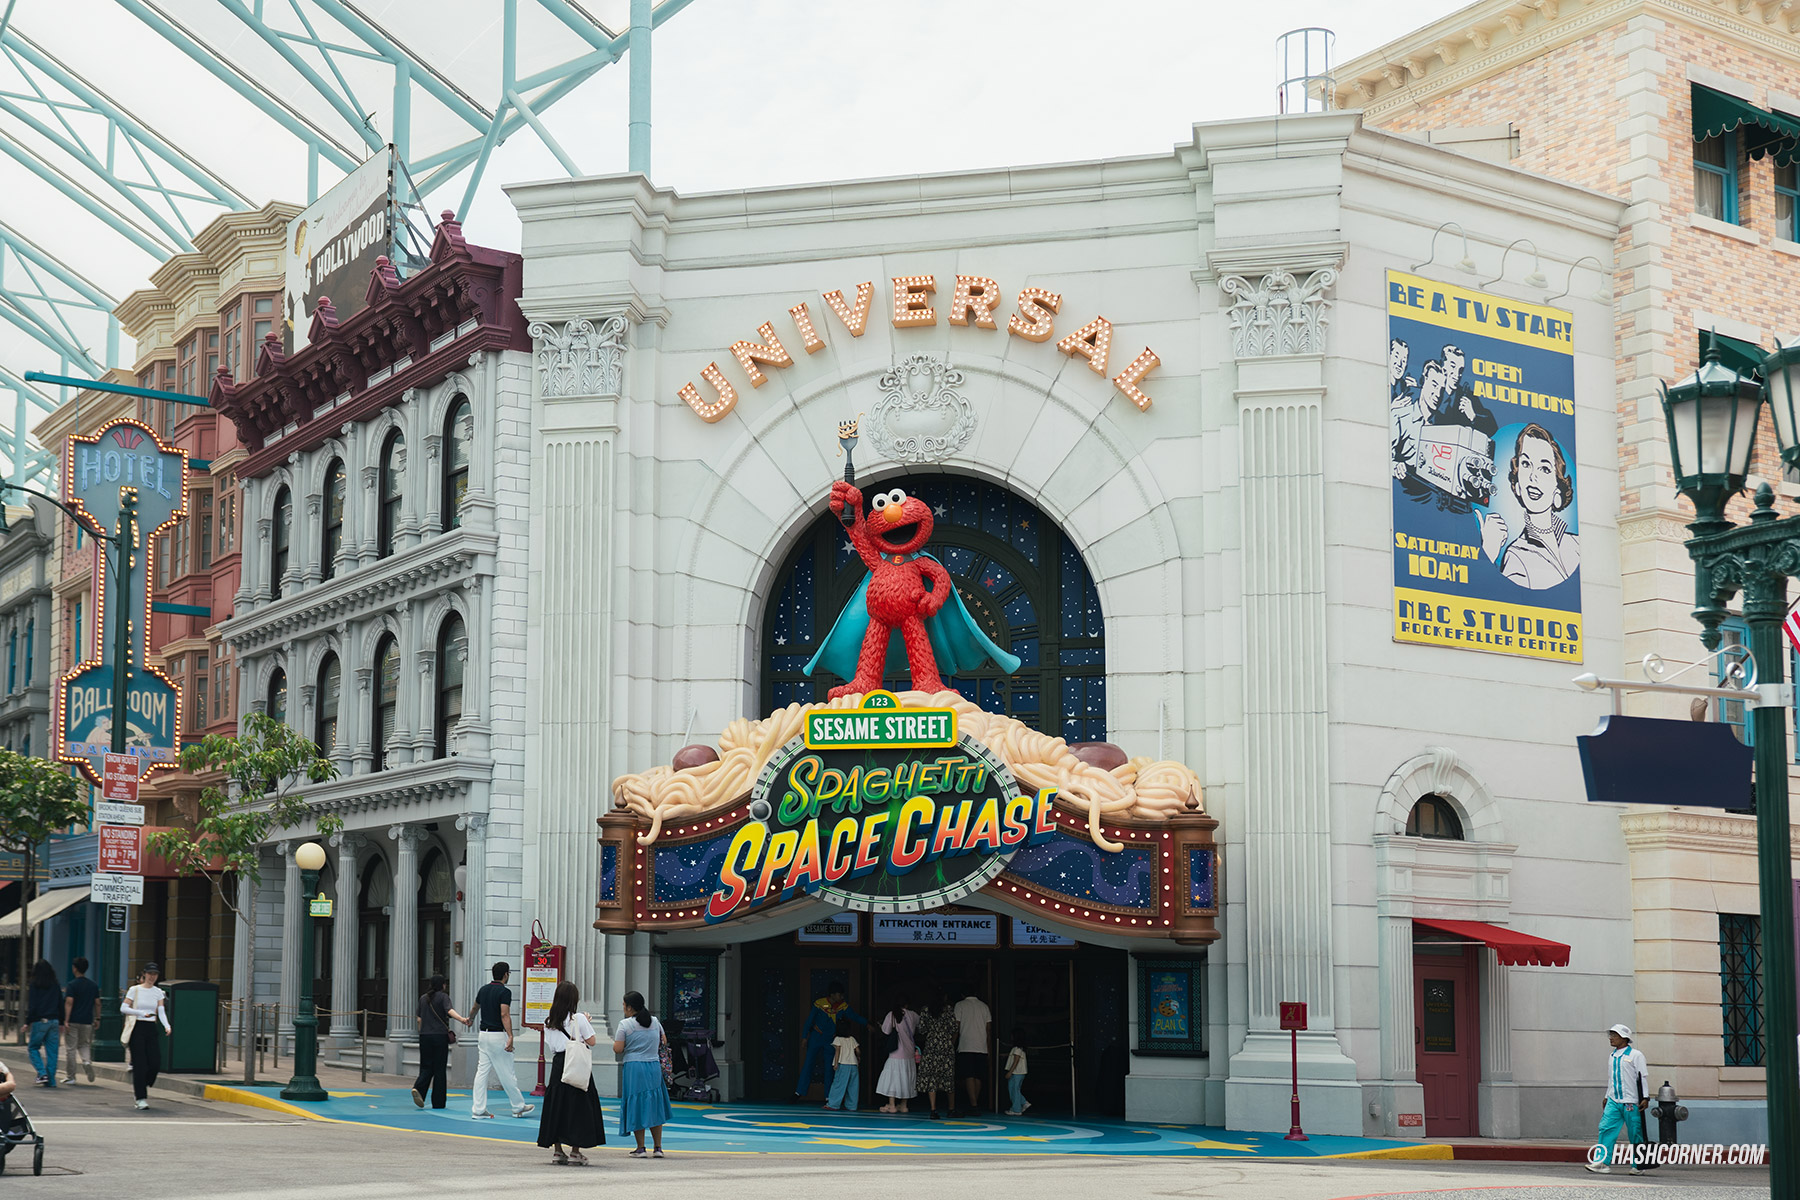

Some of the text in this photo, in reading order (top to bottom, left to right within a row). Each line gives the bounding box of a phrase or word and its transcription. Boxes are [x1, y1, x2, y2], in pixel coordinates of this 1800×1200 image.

[316, 210, 385, 286] HOLLYWOOD
[1389, 282, 1572, 342] BE A TV STAR!
[677, 274, 1162, 424] UNIVERSAL
[1472, 358, 1522, 384] OPEN
[1473, 380, 1575, 416] AUDITIONS
[1431, 444, 1453, 471] NBC
[81, 448, 172, 500] HOTEL
[1395, 532, 1480, 560] SATURDAY
[894, 555, 901, 563] E
[1399, 599, 1579, 642] NBC STUDIOS
[1401, 621, 1577, 655] ROCKEFELLER CENTER
[871, 697, 889, 707] 123
[71, 686, 168, 738] BALLOOM
[813, 715, 948, 741] SESAME STREET
[70, 742, 167, 759] DANING
[106, 755, 138, 766] SNOW ROUTE
[106, 772, 137, 783] NO STANDING
[98, 804, 118, 812] BROOKLYN
[119, 805, 134, 813] QUEENS
[98, 812, 112, 820] STATION
[102, 828, 137, 840] NO STANDING
[102, 848, 106, 858] 8
[107, 849, 117, 859] AM
[122, 850, 127, 859] 7
[127, 850, 137, 860] PM
[706, 786, 1059, 921] SPACE CHASE
[112, 876, 123, 884] NO
[93, 884, 141, 894] COMMERCIAL
[103, 892, 132, 902] TRAFFIC
[806, 924, 849, 933] SESAME STREET
[879, 920, 992, 929] ATTRACTION ENTRANCE
[913, 930, 957, 941] 景点入口
[537, 957, 548, 965] 30
[1154, 1018, 1185, 1031] PLAN C
